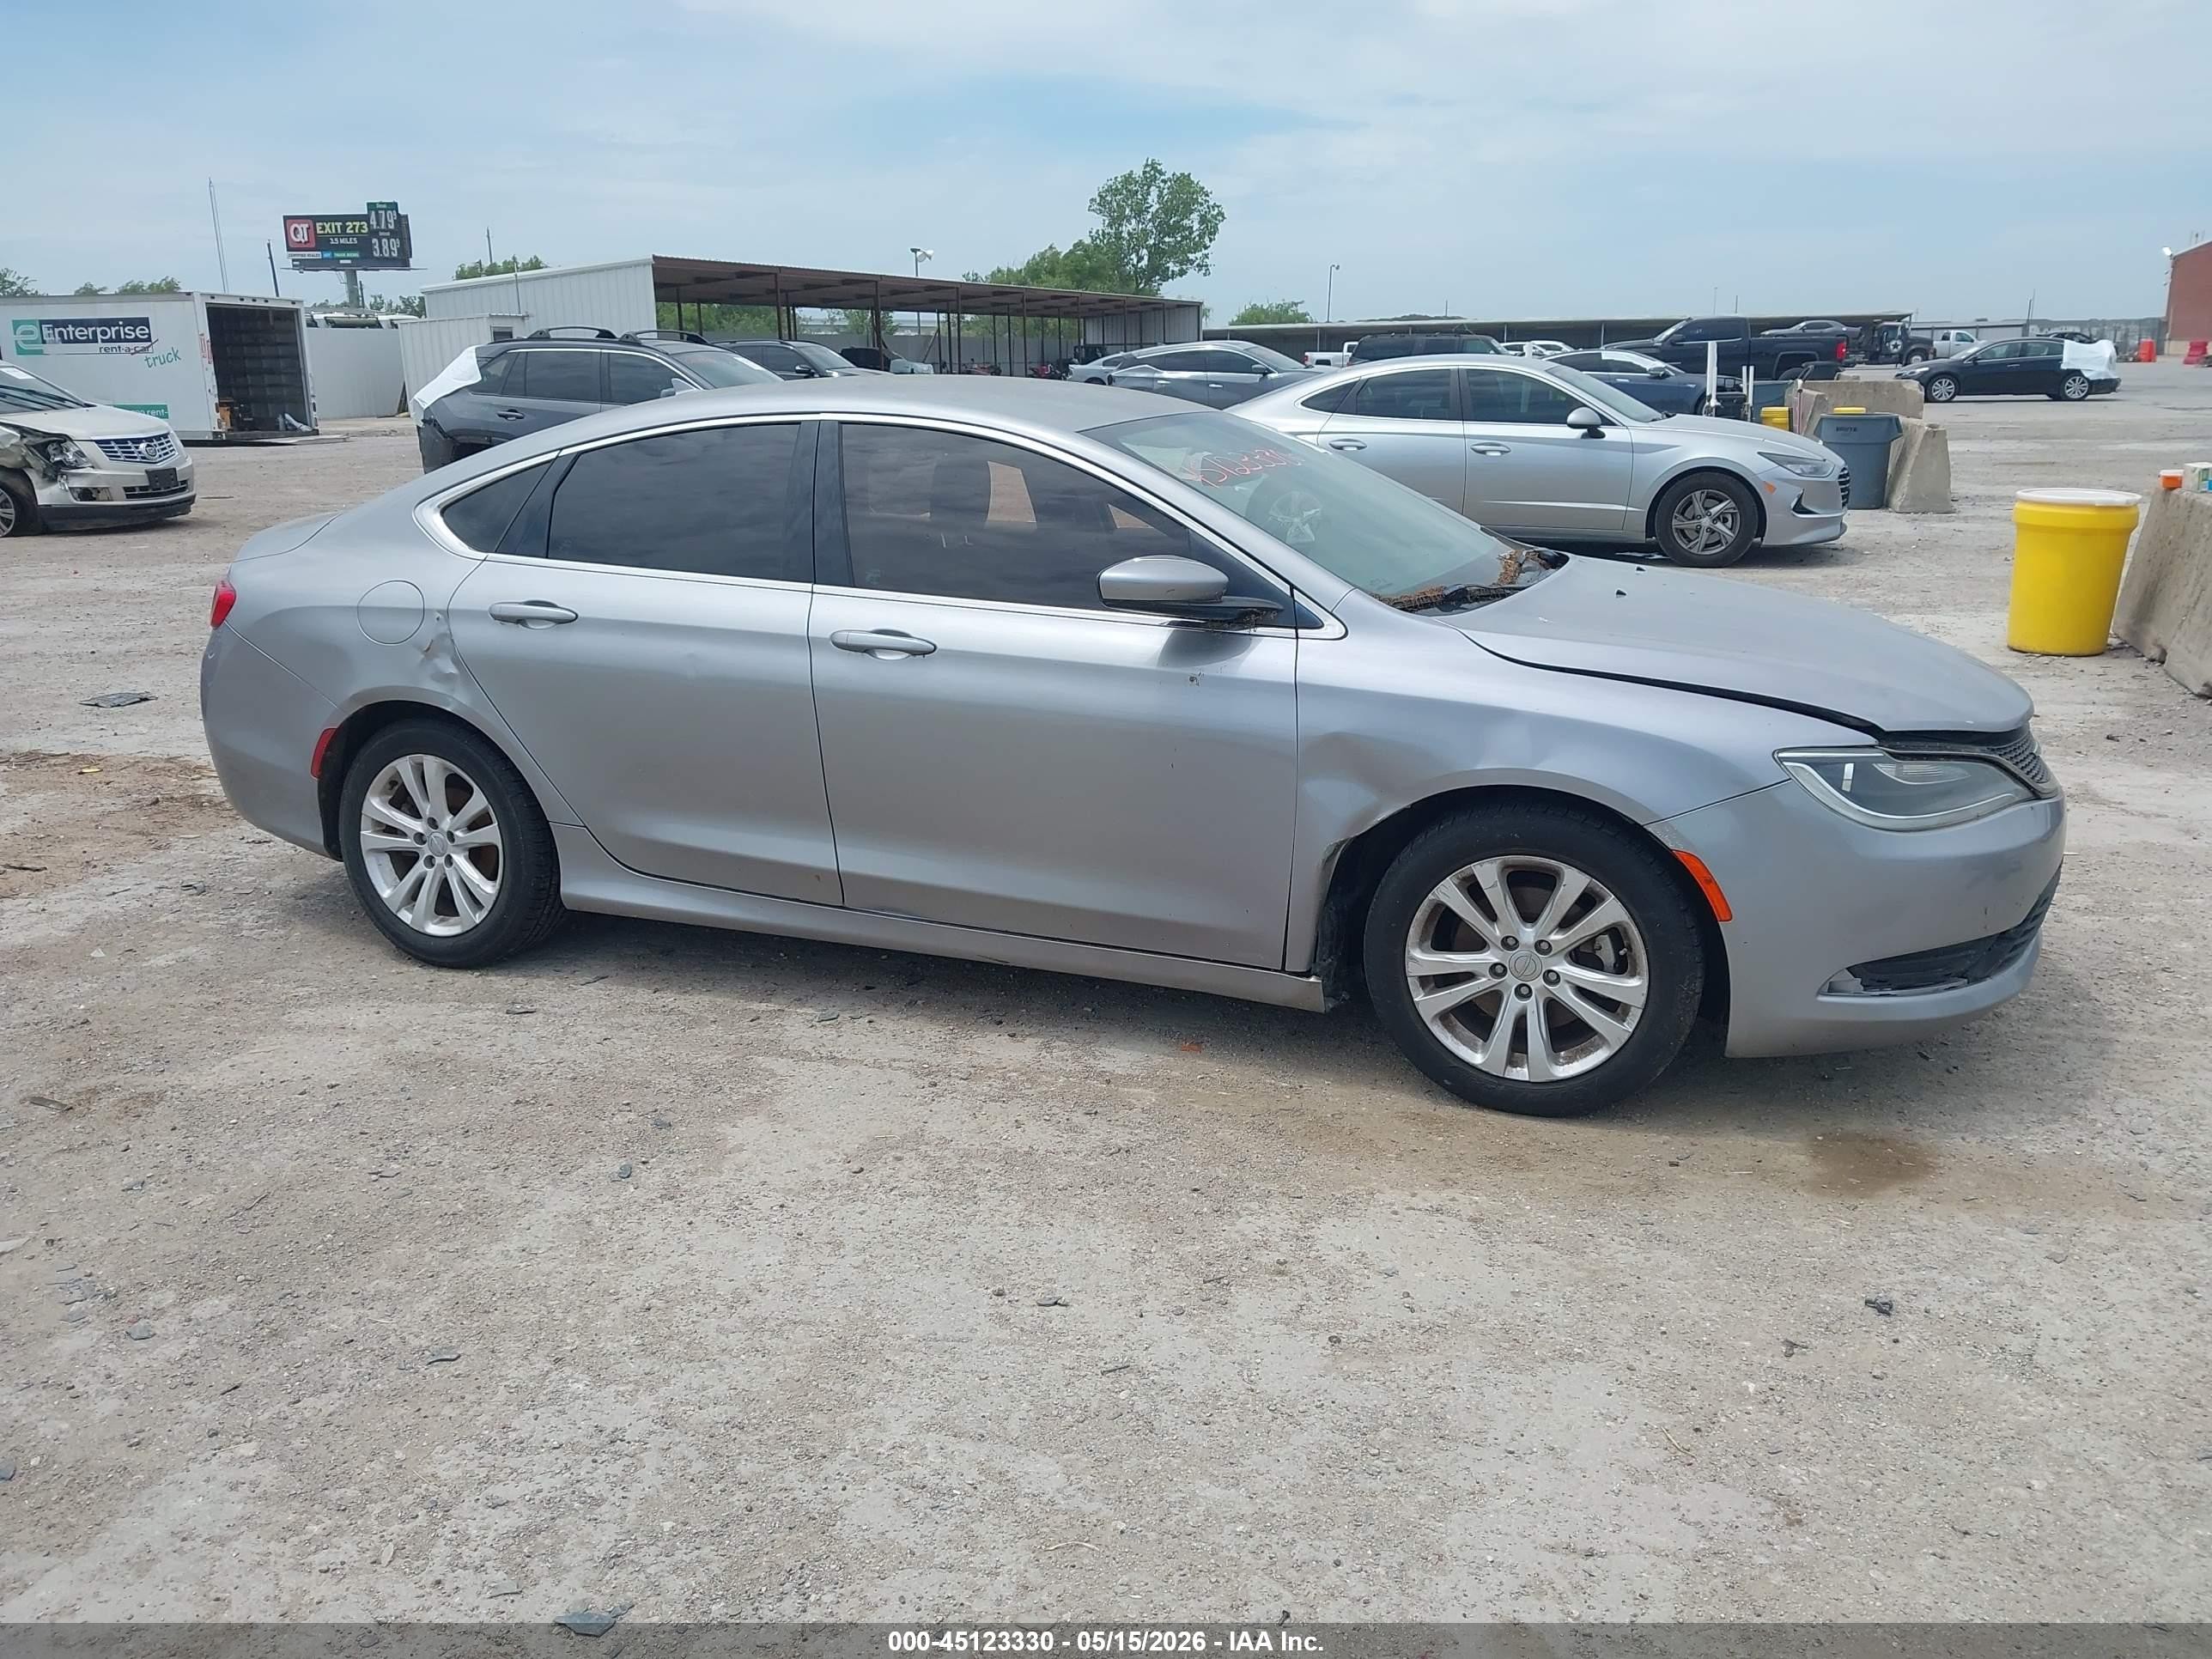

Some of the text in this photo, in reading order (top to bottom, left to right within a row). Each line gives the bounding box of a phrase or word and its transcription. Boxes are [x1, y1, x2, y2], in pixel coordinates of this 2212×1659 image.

[289, 222, 311, 244] QT
[316, 221, 368, 234] EXIT 273
[41, 321, 149, 344] Enterprise
[99, 345, 151, 354] rent-a-car
[144, 347, 182, 368] truck
